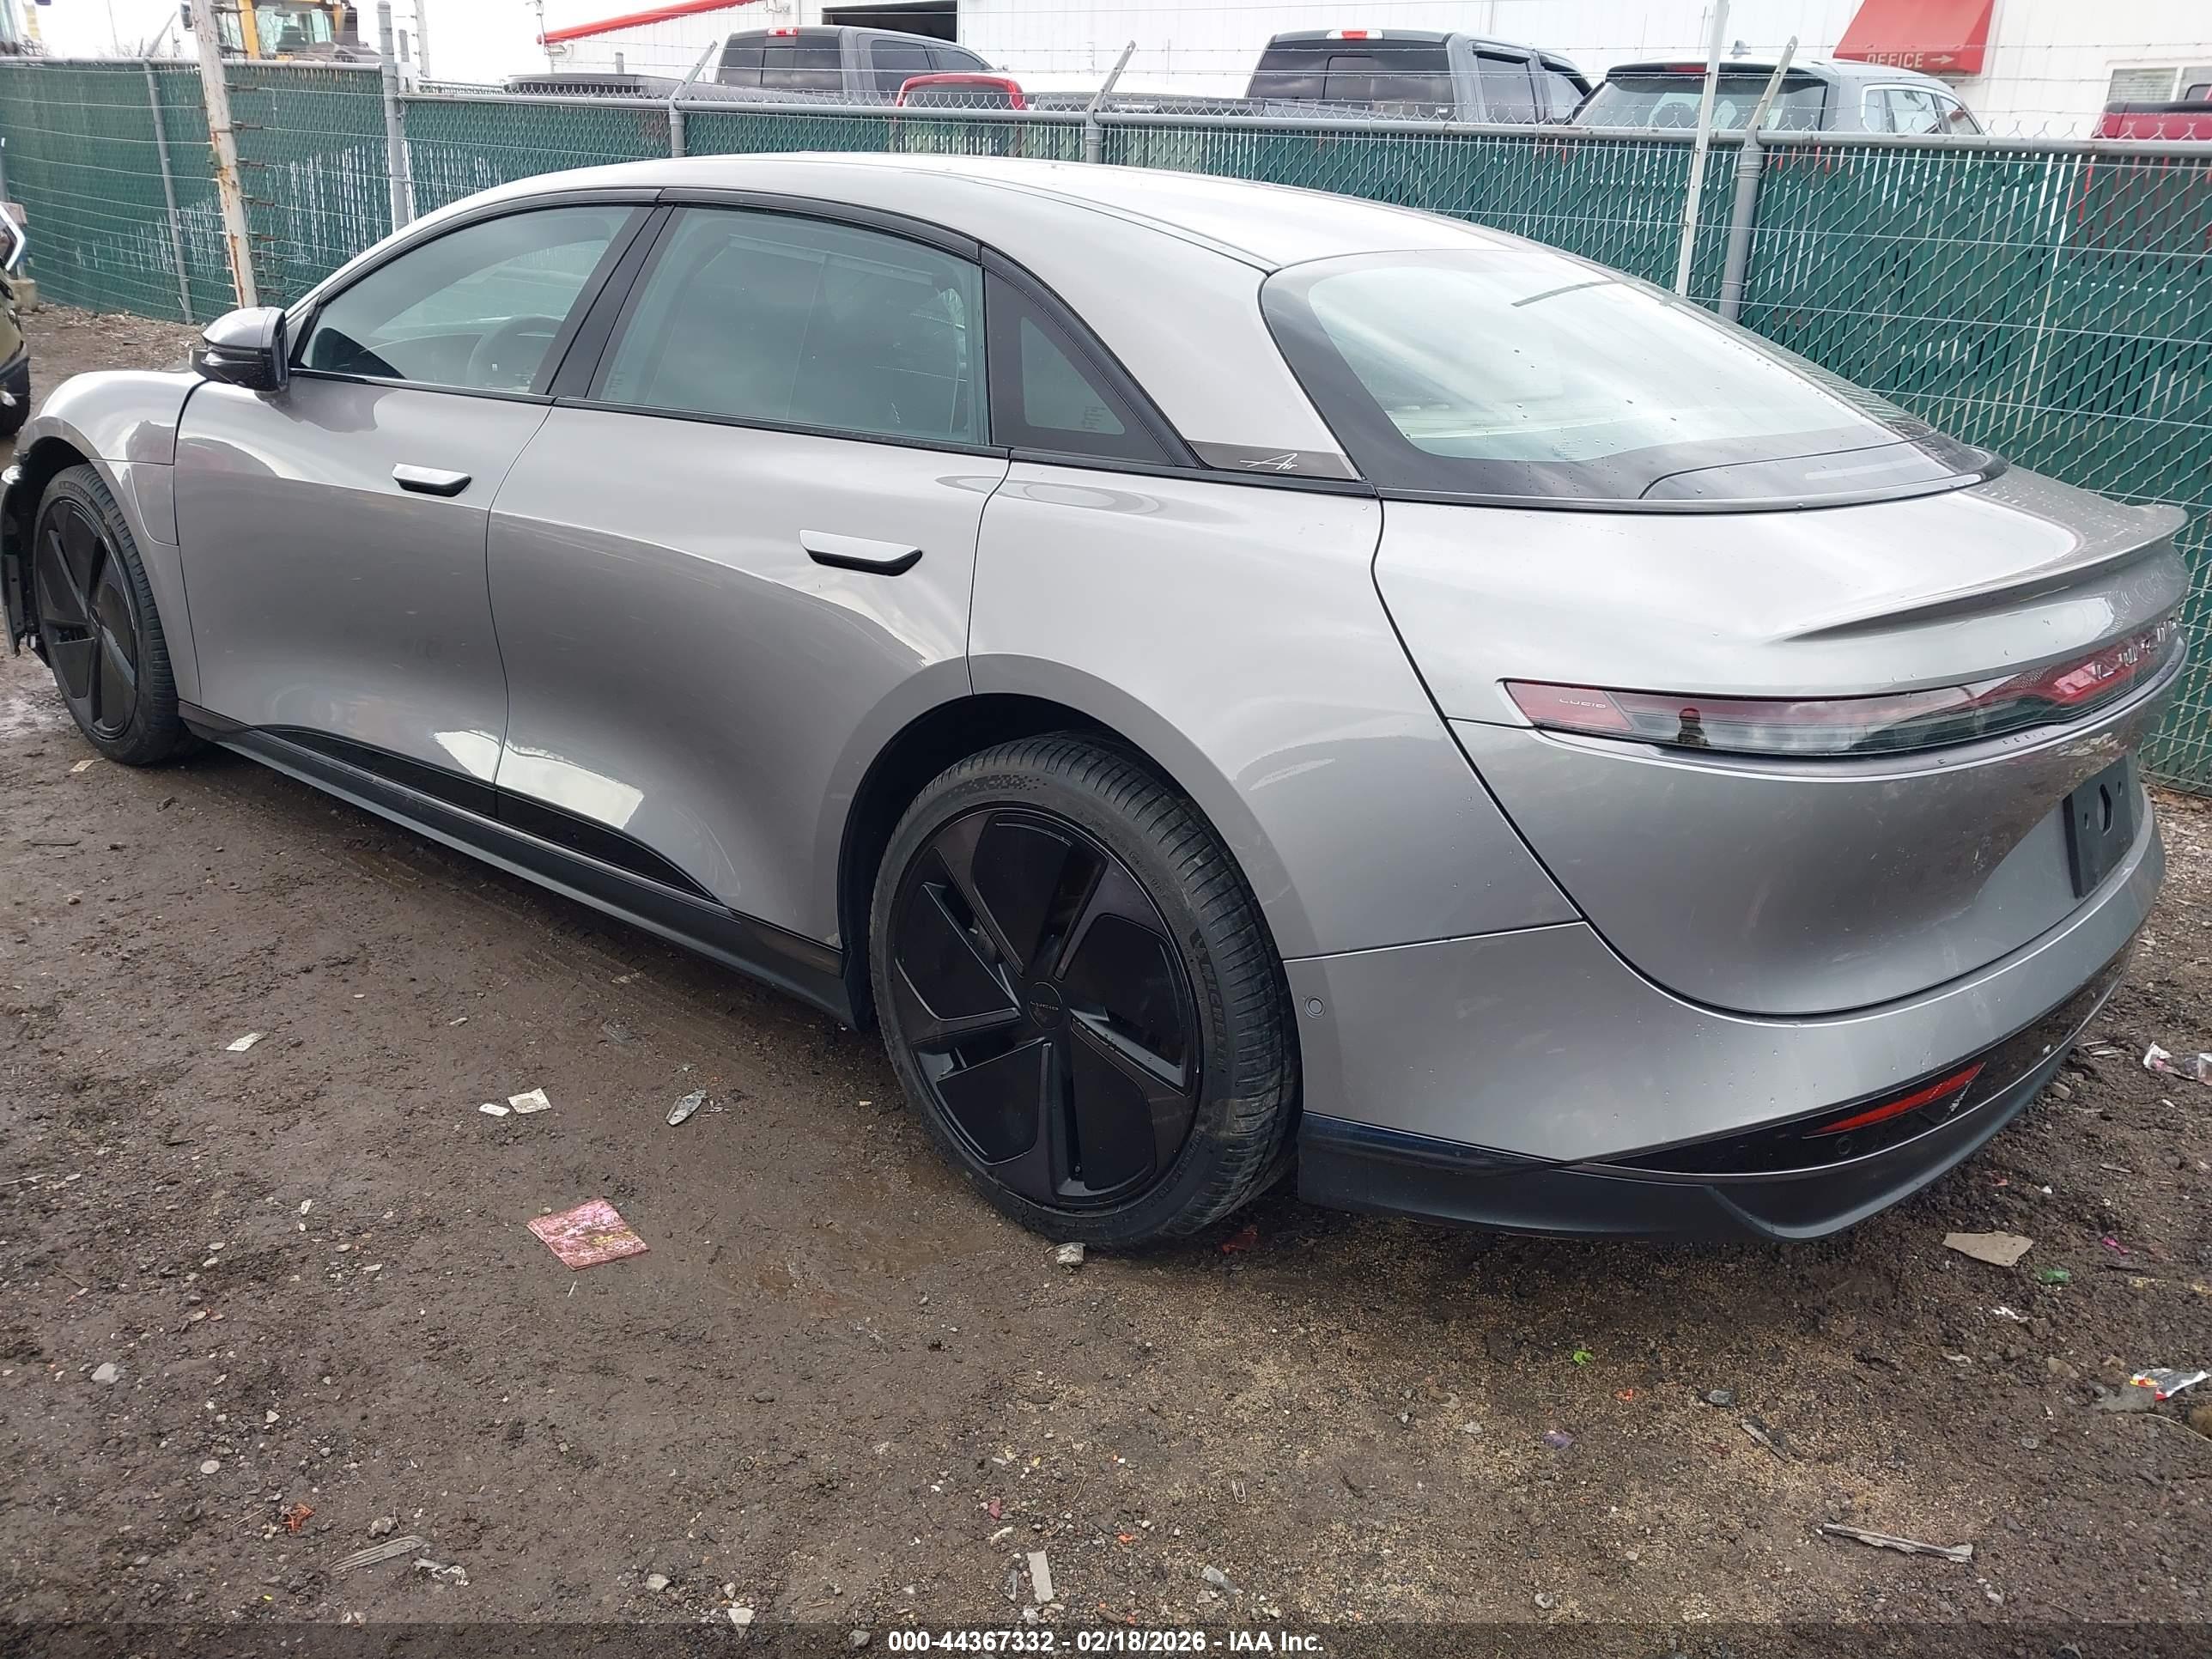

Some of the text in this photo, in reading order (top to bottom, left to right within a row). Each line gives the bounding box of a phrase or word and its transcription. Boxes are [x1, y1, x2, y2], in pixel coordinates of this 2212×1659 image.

[1867, 52, 1925, 68] OFFICE
[1239, 453, 1298, 471] Air
[1559, 698, 1607, 708] LUCID
